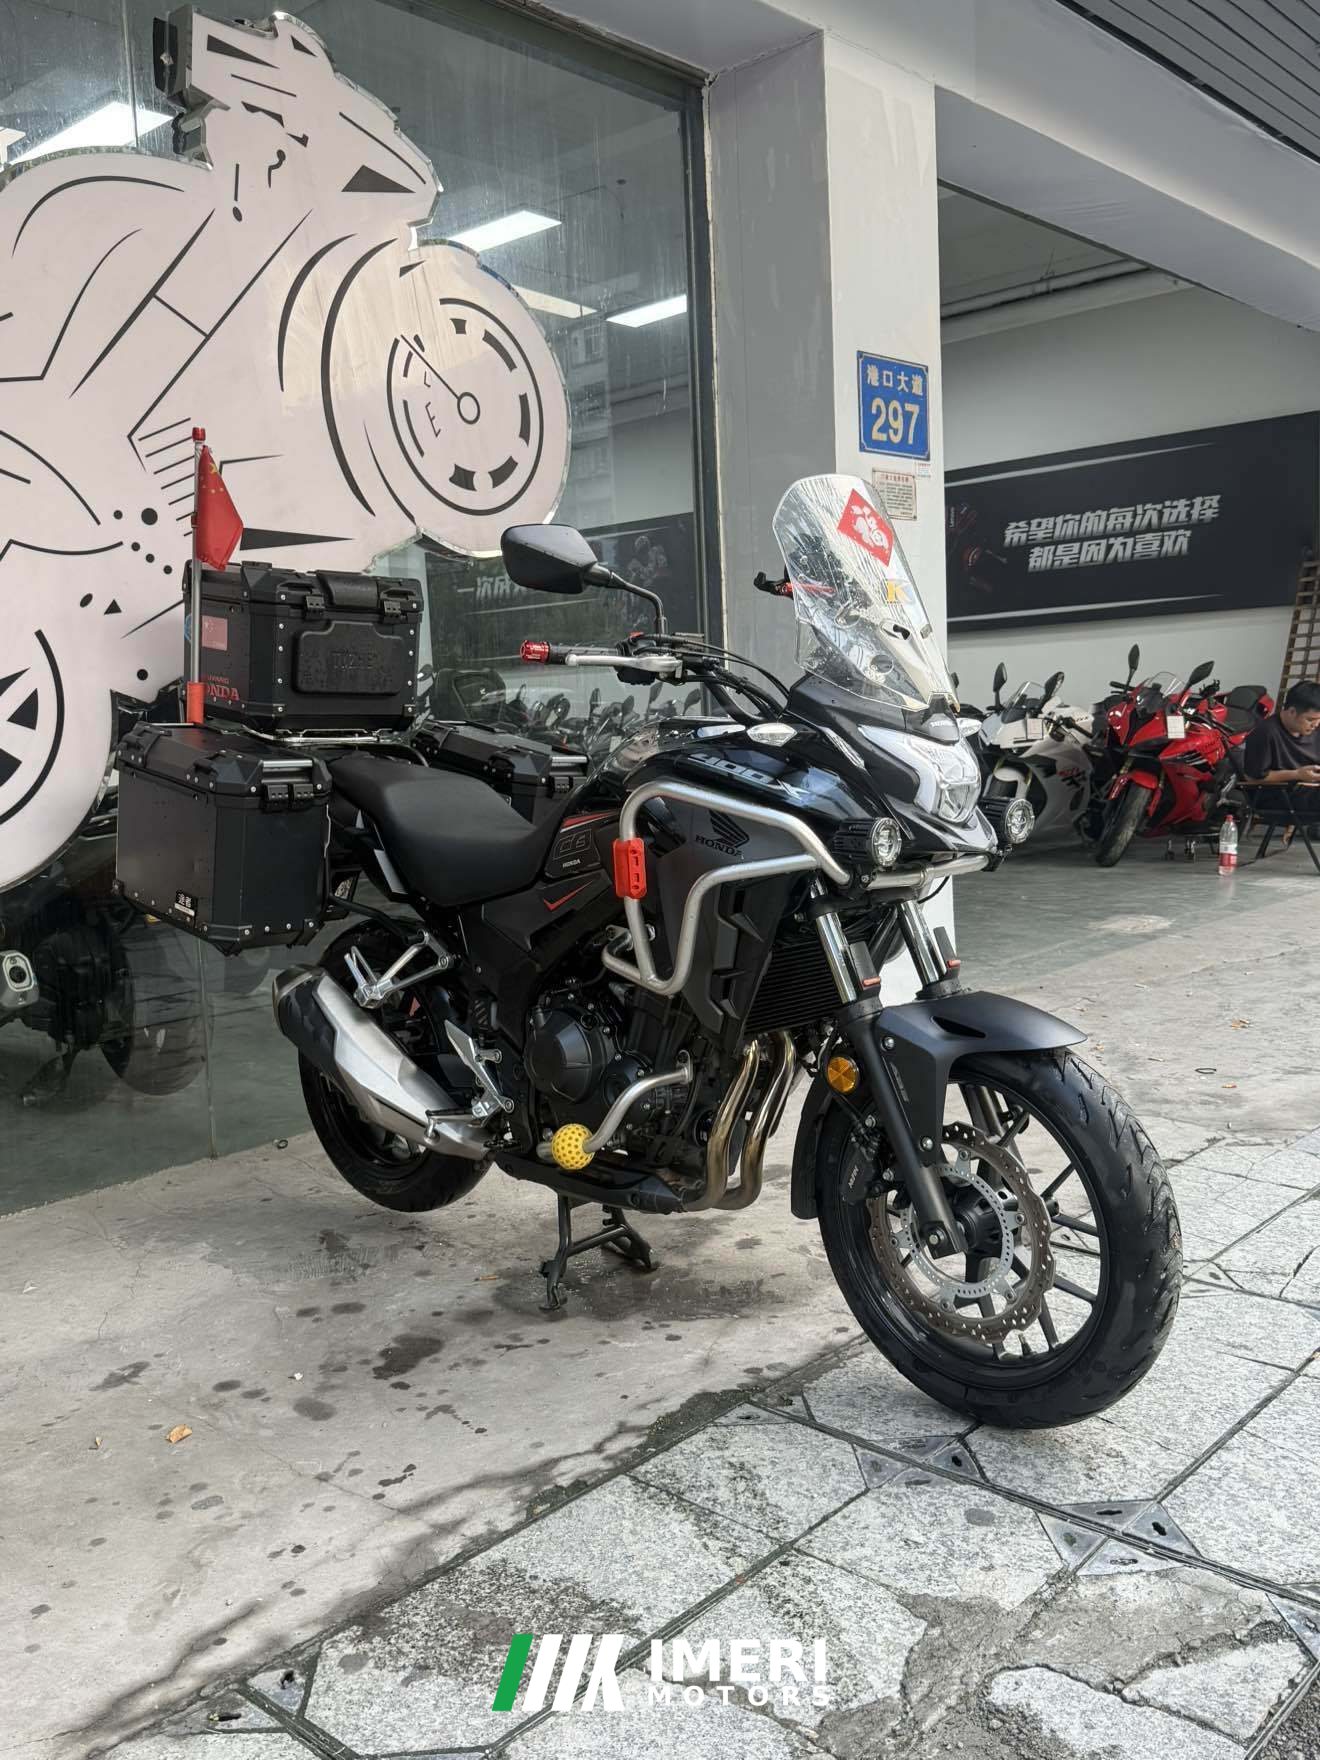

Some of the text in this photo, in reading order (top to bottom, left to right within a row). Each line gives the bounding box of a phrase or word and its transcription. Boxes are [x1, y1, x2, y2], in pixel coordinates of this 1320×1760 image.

[871, 397, 920, 445] 297
[1004, 495, 1222, 547] 希望你的每次选择
[1028, 529, 1192, 572] 都是因为喜欢
[696, 835, 744, 860] HONDA
